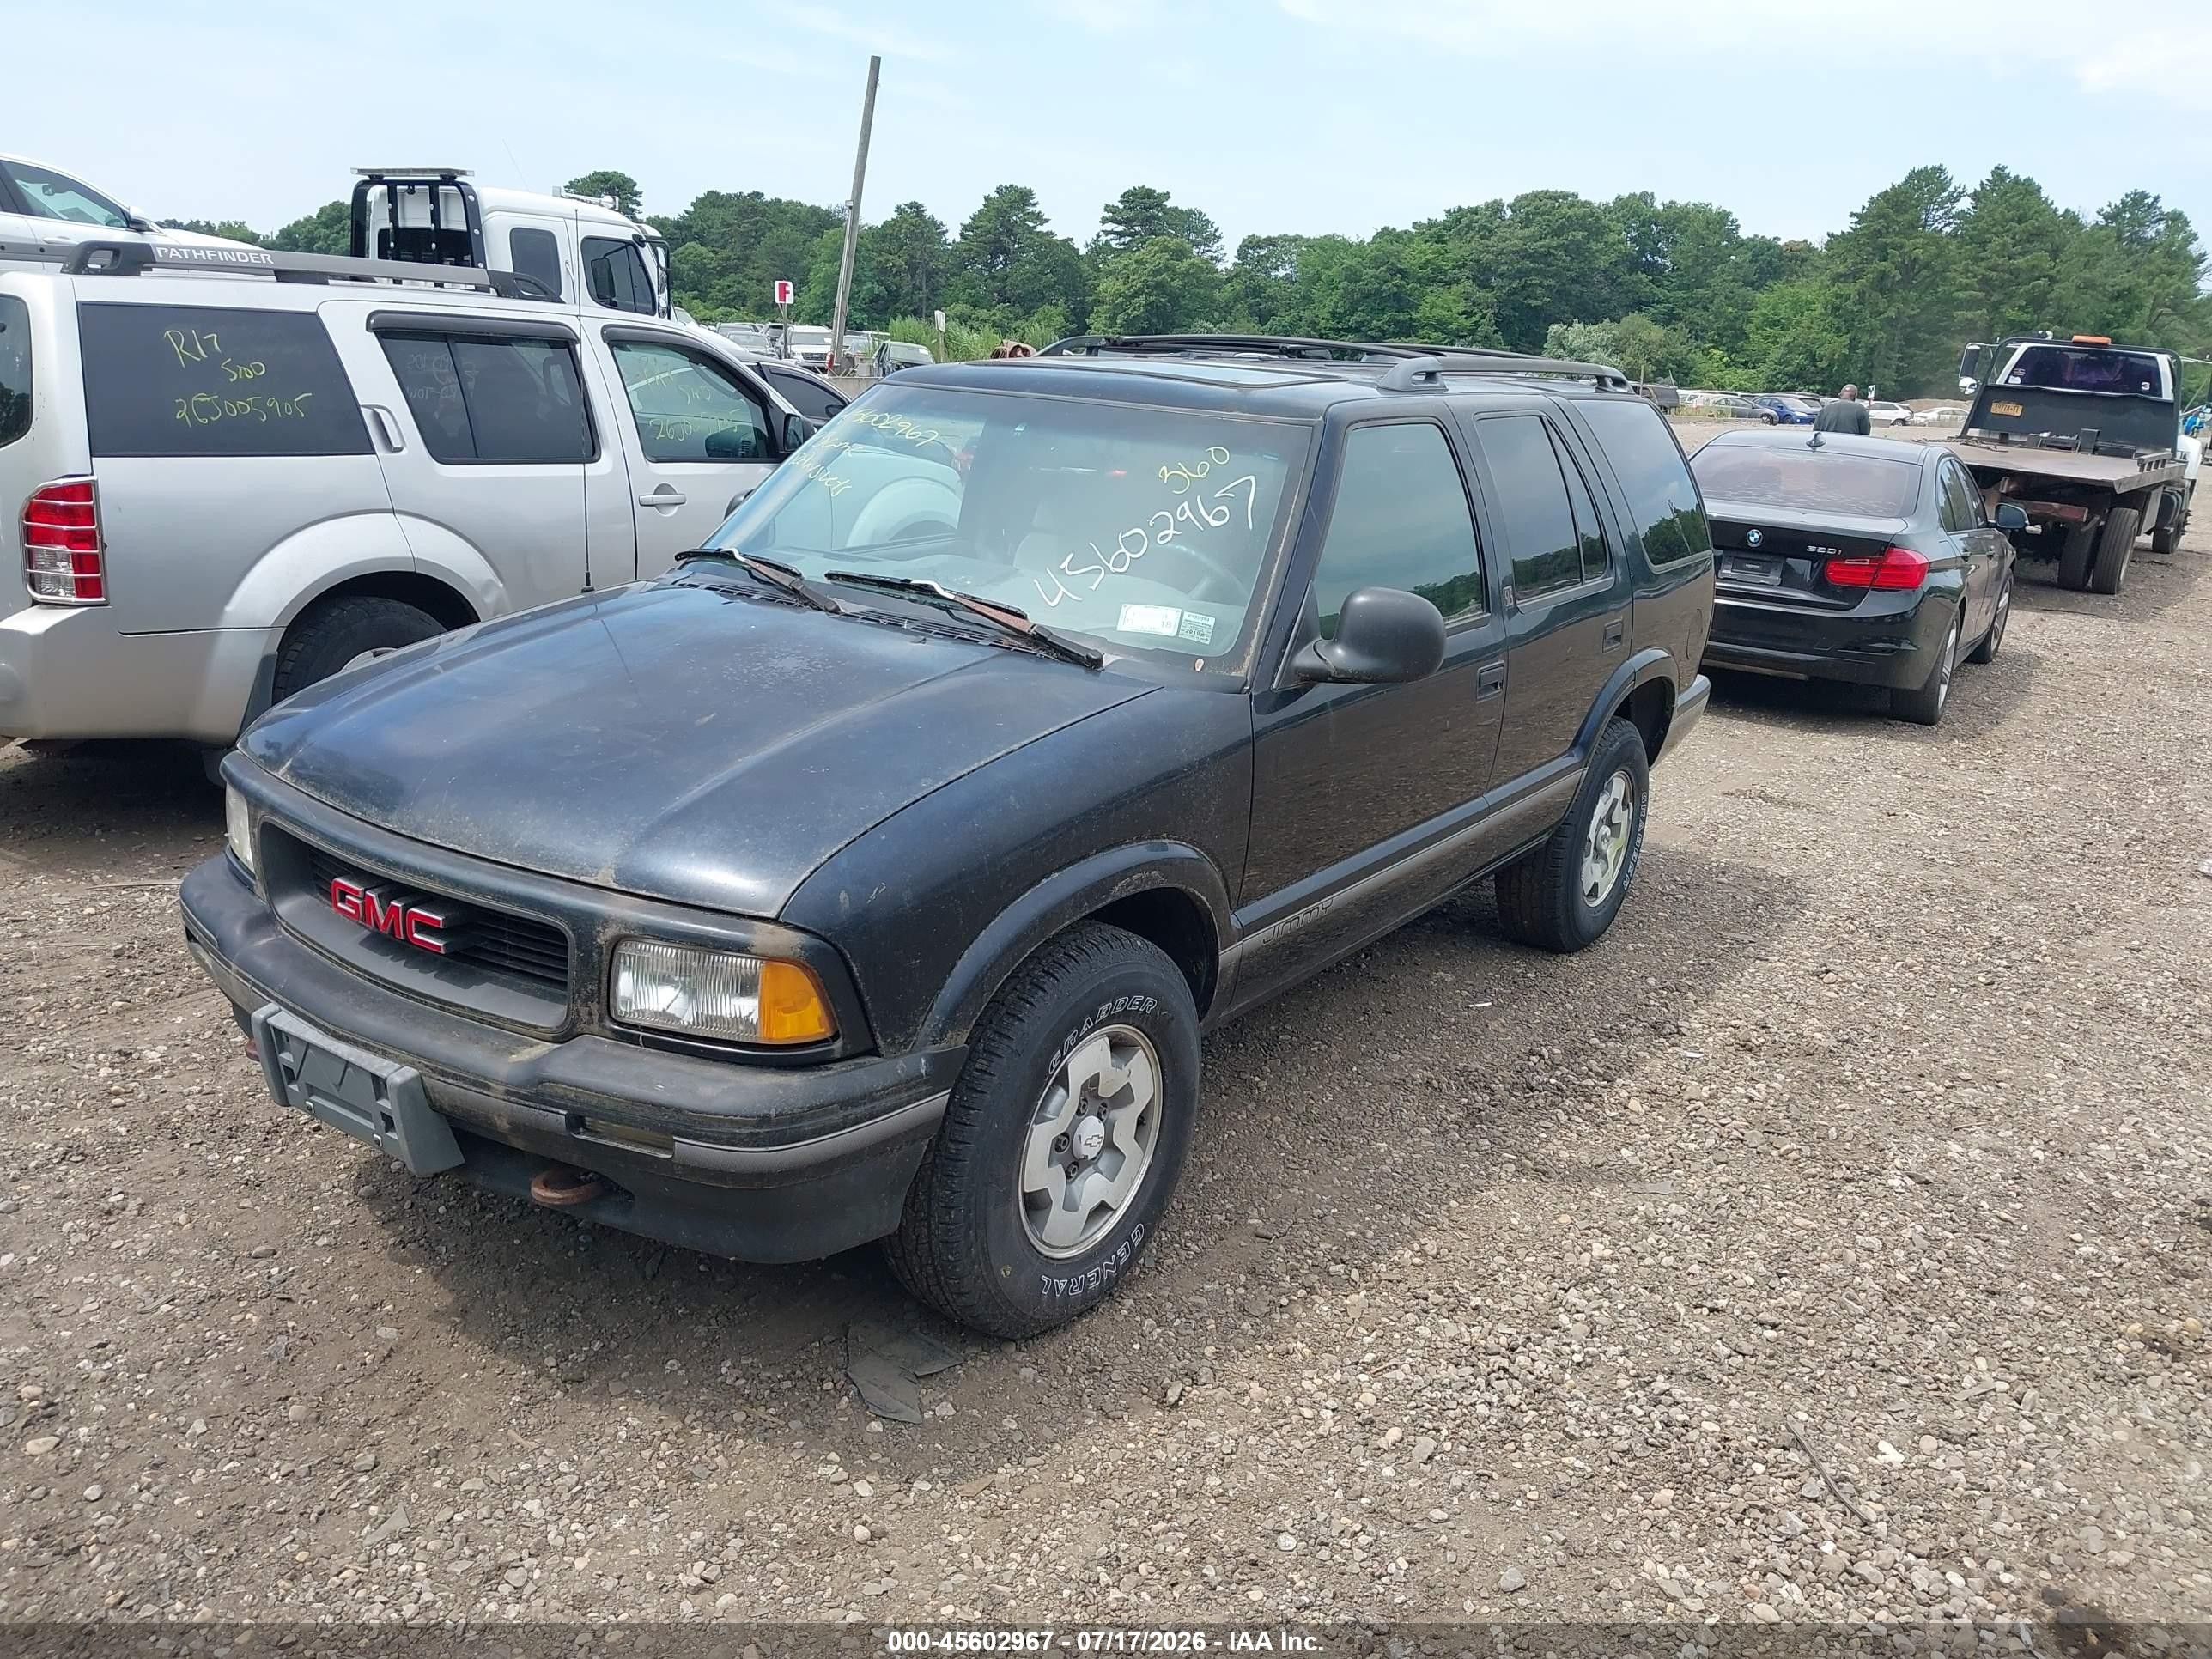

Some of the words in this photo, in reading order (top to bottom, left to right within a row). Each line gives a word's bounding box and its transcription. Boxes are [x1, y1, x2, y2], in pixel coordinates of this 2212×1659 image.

[156, 246, 274, 264] PATHFINDER
[778, 282, 790, 301] F
[2141, 381, 2151, 391] 3
[1158, 446, 1230, 494] 360
[1033, 475, 1256, 608] 45602967
[331, 878, 447, 955] GMC
[1048, 995, 1158, 1075] GRABBER
[1041, 1223, 1146, 1297] GENERAL
